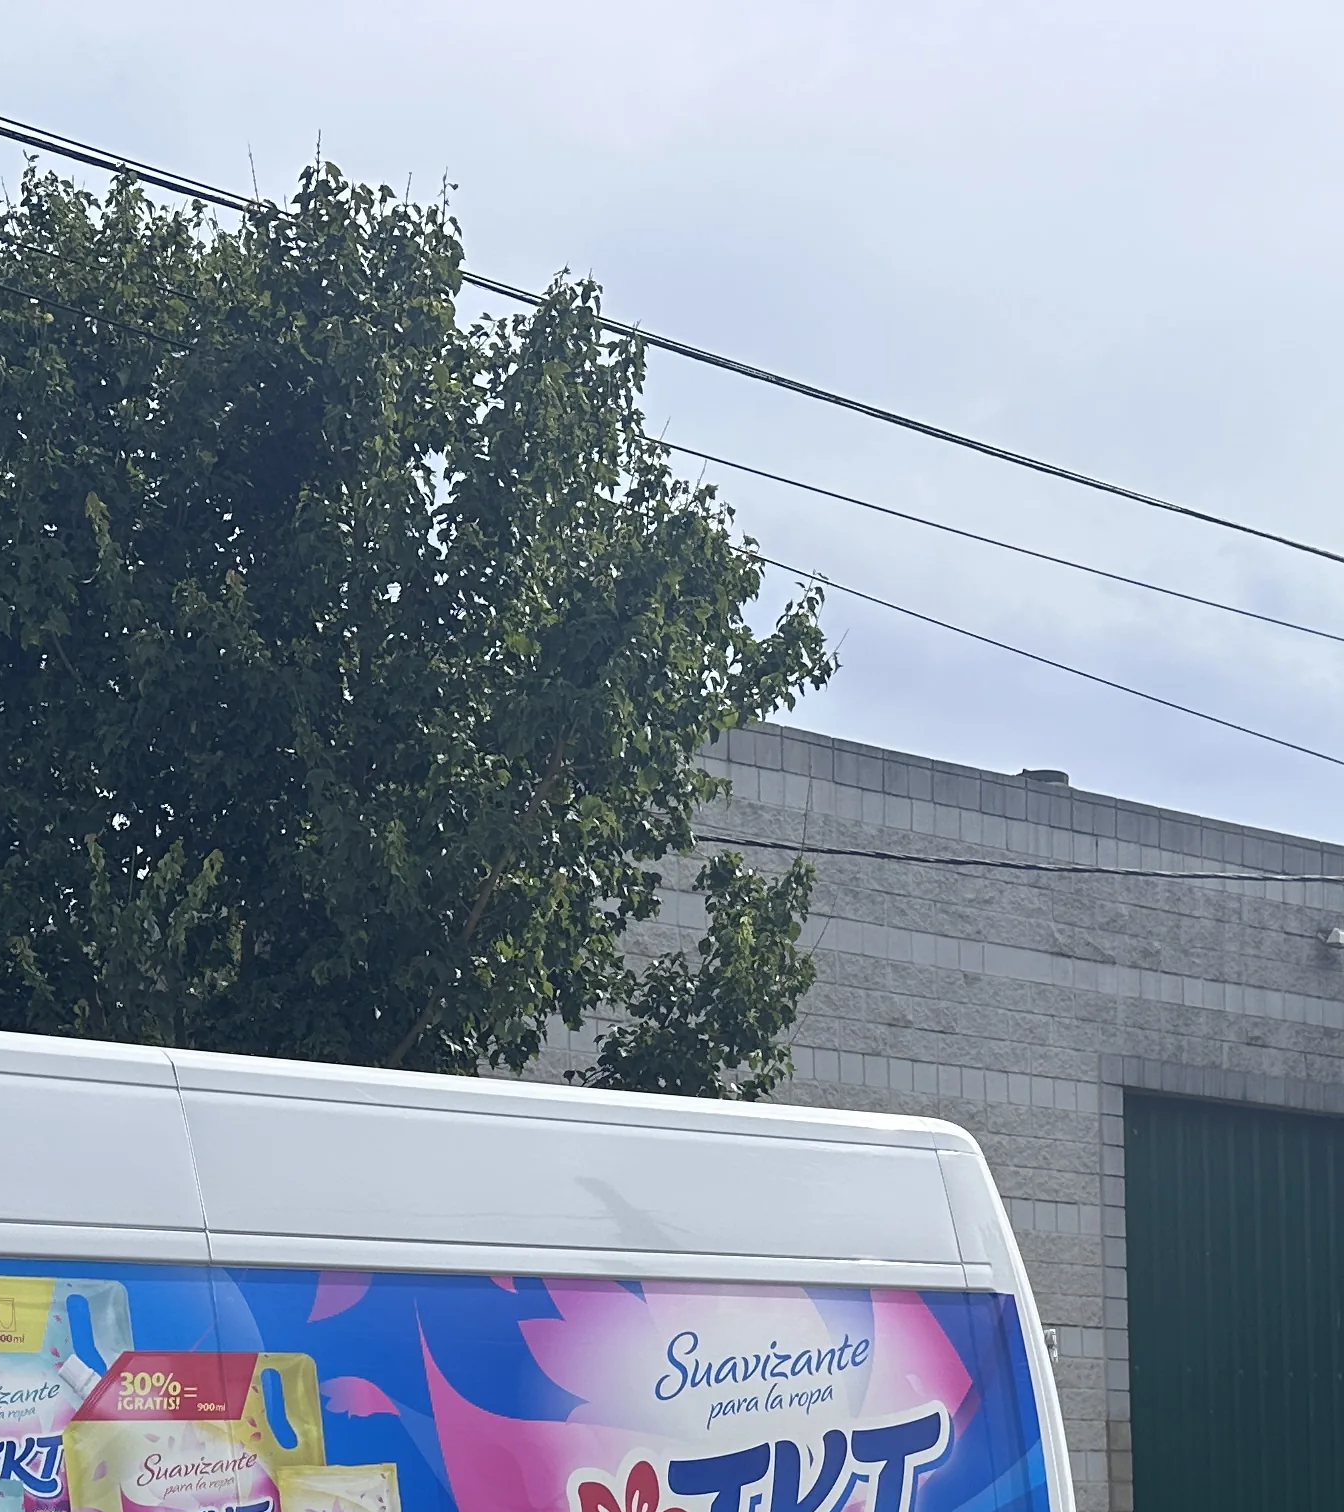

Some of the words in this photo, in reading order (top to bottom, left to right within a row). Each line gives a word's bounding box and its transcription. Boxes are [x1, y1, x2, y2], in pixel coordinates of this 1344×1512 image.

[655, 1331, 870, 1400] Suavizante
[119, 1372, 181, 1396] 30%
[7, 1406, 35, 1423] ropa
[117, 1396, 180, 1411] ¡GRATIS!
[706, 1396, 759, 1430] para
[764, 1383, 783, 1412] la
[788, 1385, 834, 1415] ropa
[137, 1453, 257, 1486] Suavizante
[164, 1483, 193, 1499] para
[195, 1477, 206, 1491] la
[208, 1476, 235, 1492] ropa
